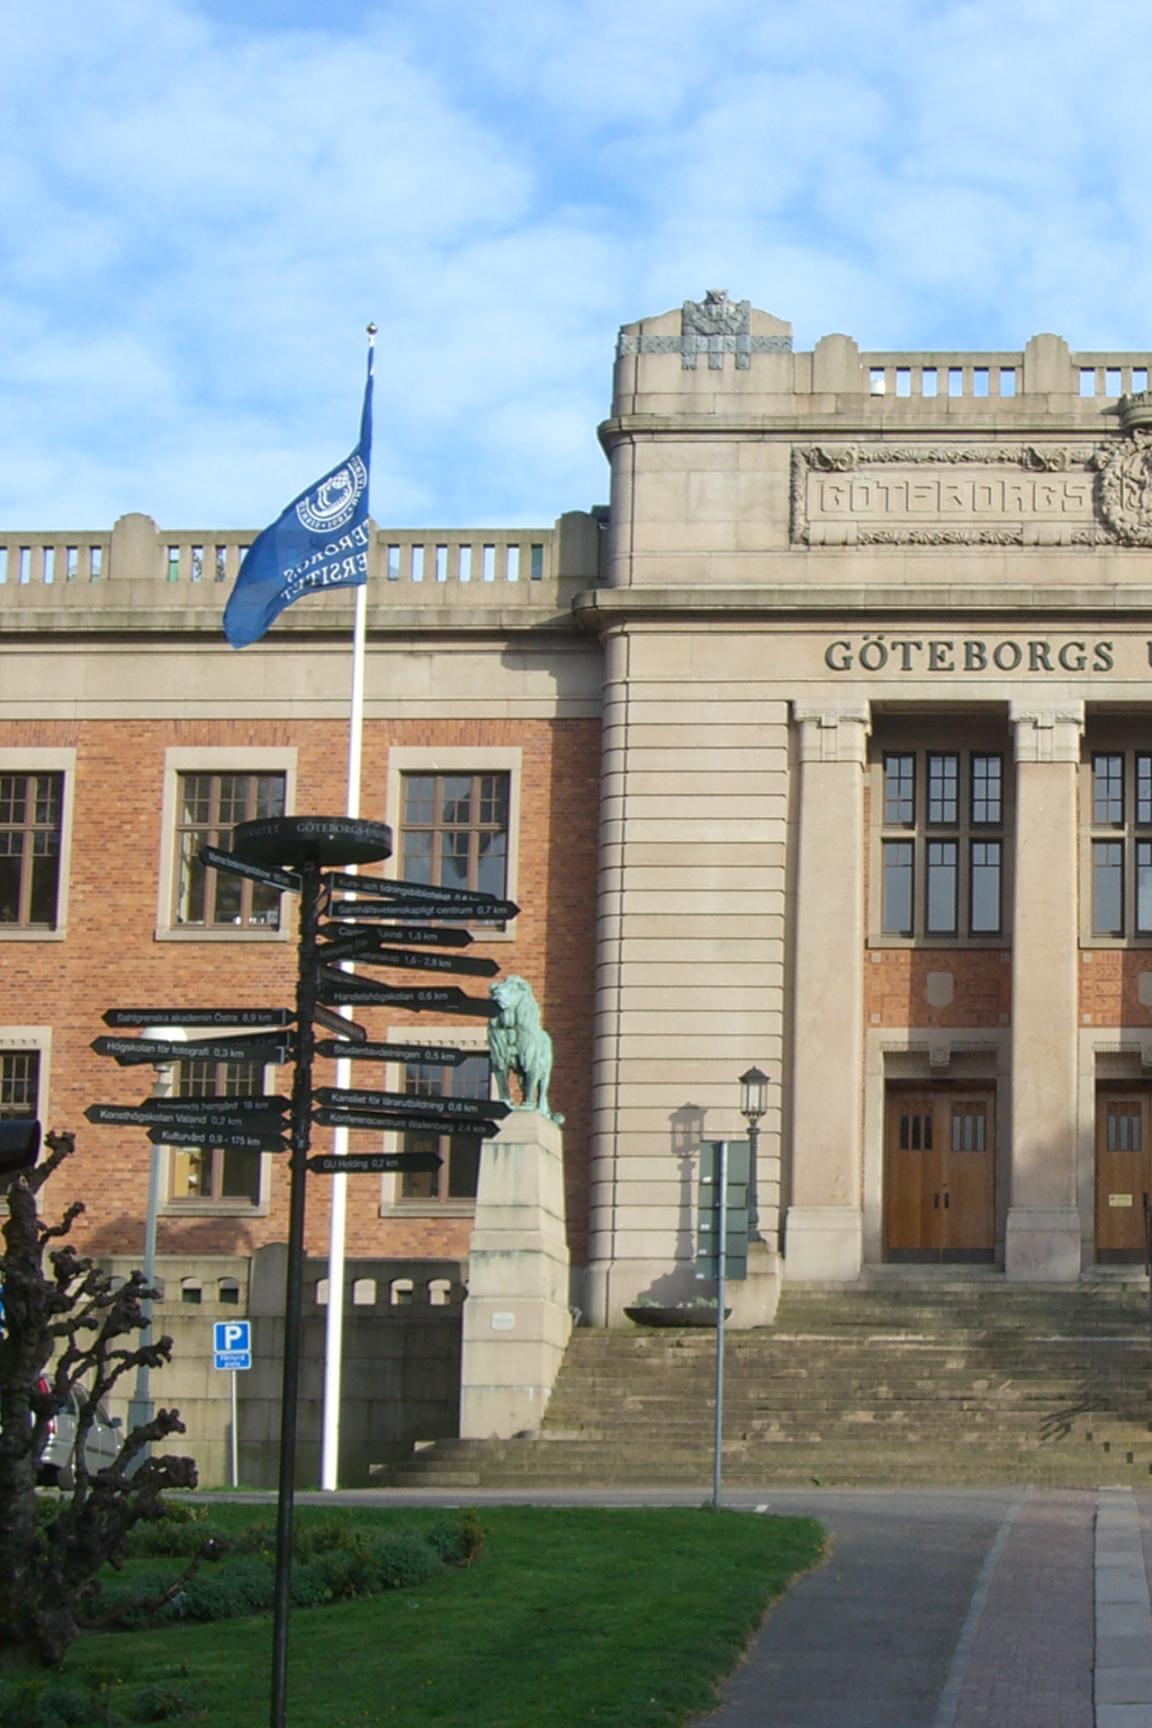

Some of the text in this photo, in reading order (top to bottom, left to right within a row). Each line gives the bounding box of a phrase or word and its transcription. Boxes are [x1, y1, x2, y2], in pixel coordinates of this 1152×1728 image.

[825, 635, 1114, 672] GÖTEBORGS
[296, 822, 364, 835] GÖTEBORGS
[436, 906, 472, 915] centrum
[477, 906, 492, 915] 0,7
[493, 906, 508, 915] km
[423, 932, 438, 941] km
[438, 958, 452, 967] km
[434, 991, 448, 1000] km
[258, 1012, 272, 1022] km
[107, 1040, 156, 1053] Högskolan
[157, 1042, 170, 1053] för
[172, 1044, 209, 1057] fotografi
[230, 1048, 244, 1058] km
[441, 1052, 455, 1061] km
[255, 1100, 269, 1109] km
[368, 1094, 381, 1105] för
[464, 1104, 478, 1113] km
[100, 1109, 242, 1126] Konsthögskolan Valand 0,2 km
[473, 1124, 486, 1133] km
[162, 1130, 205, 1143] Kulturvård
[231, 1134, 245, 1145] 175
[247, 1136, 260, 1146] km
[338, 1159, 368, 1170] Holding
[386, 1158, 399, 1167] km
[225, 1326, 242, 1349] P
